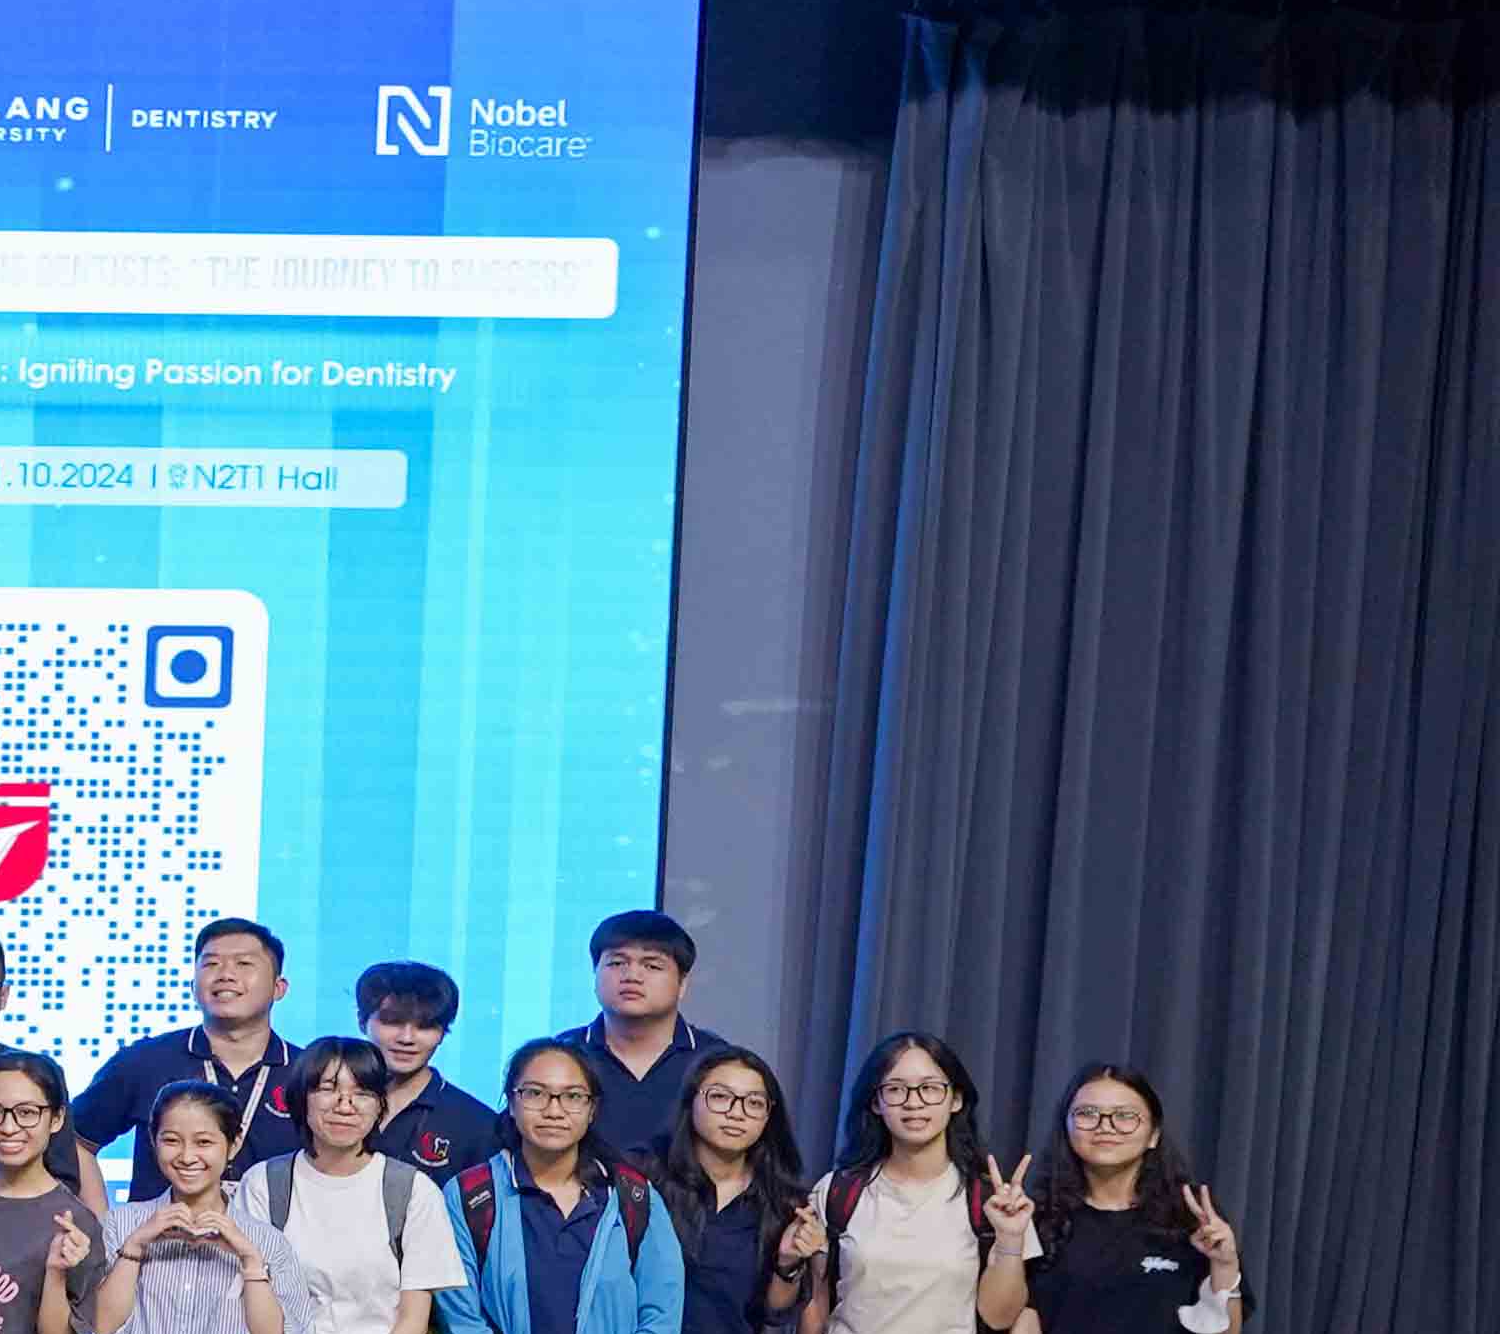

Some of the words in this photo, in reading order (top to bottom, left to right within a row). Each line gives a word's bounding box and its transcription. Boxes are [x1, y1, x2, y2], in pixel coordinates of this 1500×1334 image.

[132, 110, 276, 128] DENTISTRY
[471, 99, 567, 130] Nobel
[470, 129, 586, 157] Biocare
[19, 358, 135, 389] Igniting
[145, 358, 261, 384] Passion
[272, 360, 313, 385] for
[322, 361, 456, 392] Dentistry
[197, 464, 263, 491] N2T1
[279, 466, 338, 491] Hall
